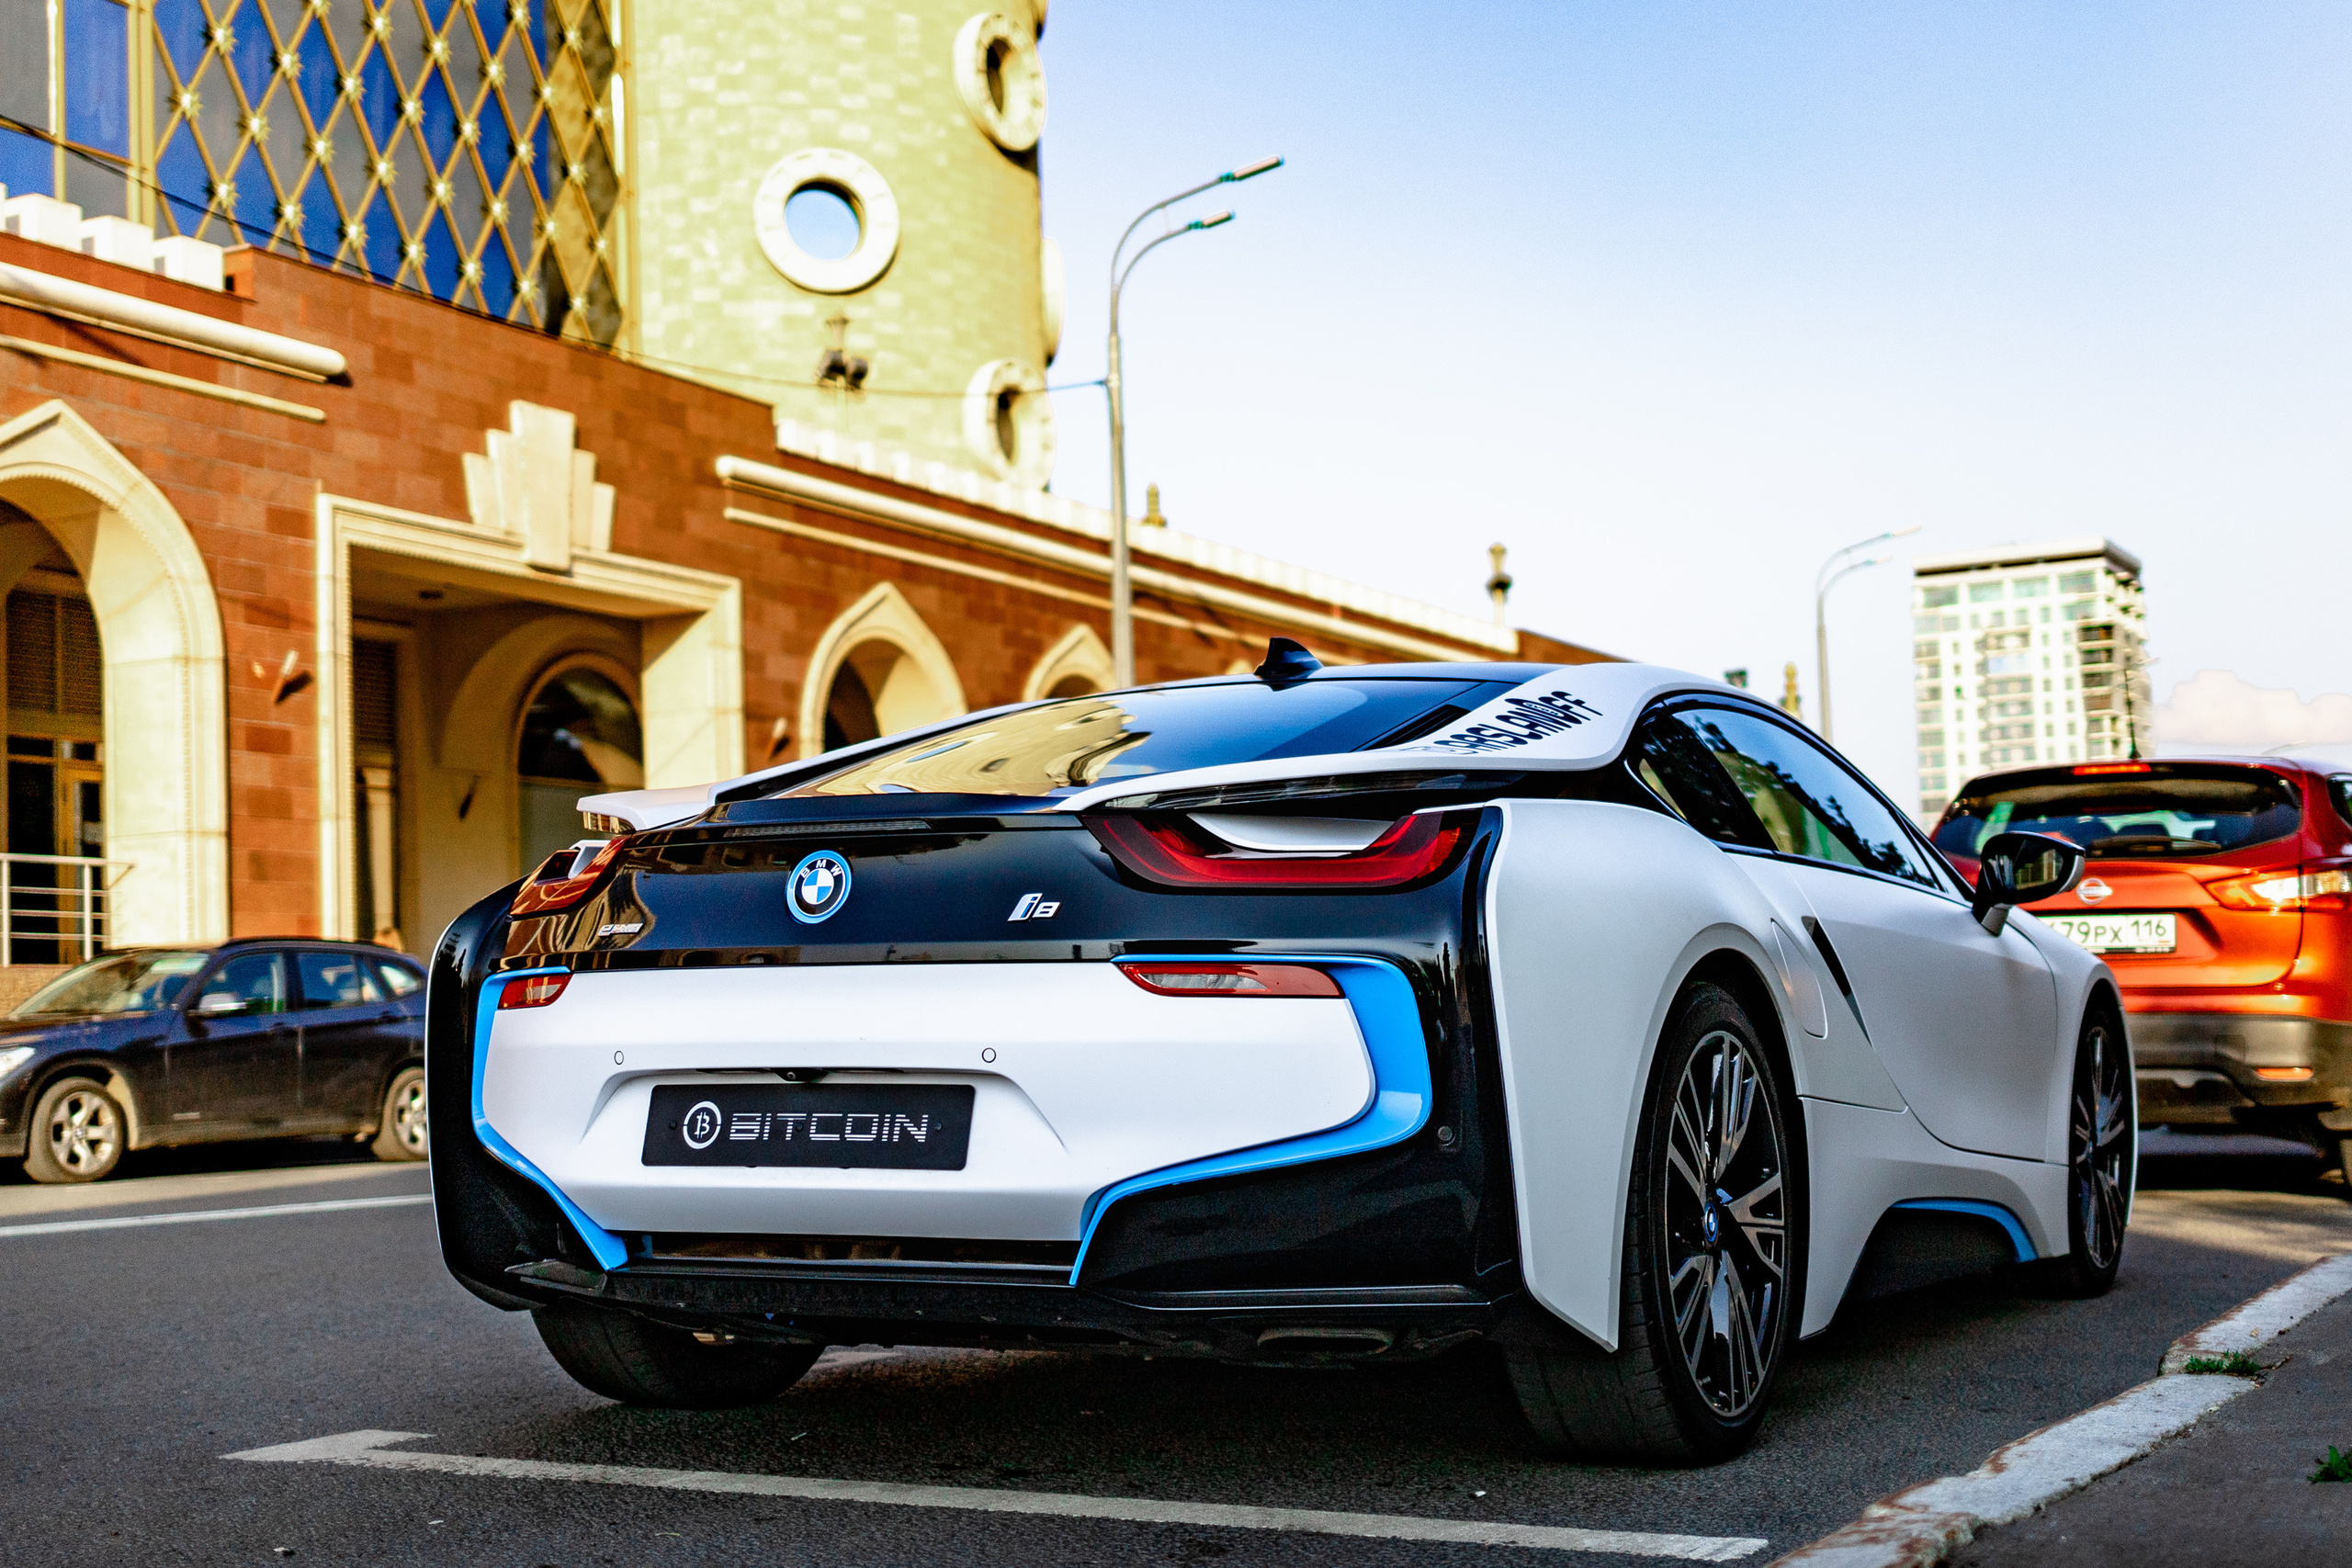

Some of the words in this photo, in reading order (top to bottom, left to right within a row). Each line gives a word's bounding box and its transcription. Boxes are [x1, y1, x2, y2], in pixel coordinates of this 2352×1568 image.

[800, 859, 842, 878] BMW
[1008, 893, 1061, 921] i8
[2050, 921, 2122, 943] 79PX
[2131, 919, 2166, 937] 116
[729, 1113, 929, 1142] BITCOIN
